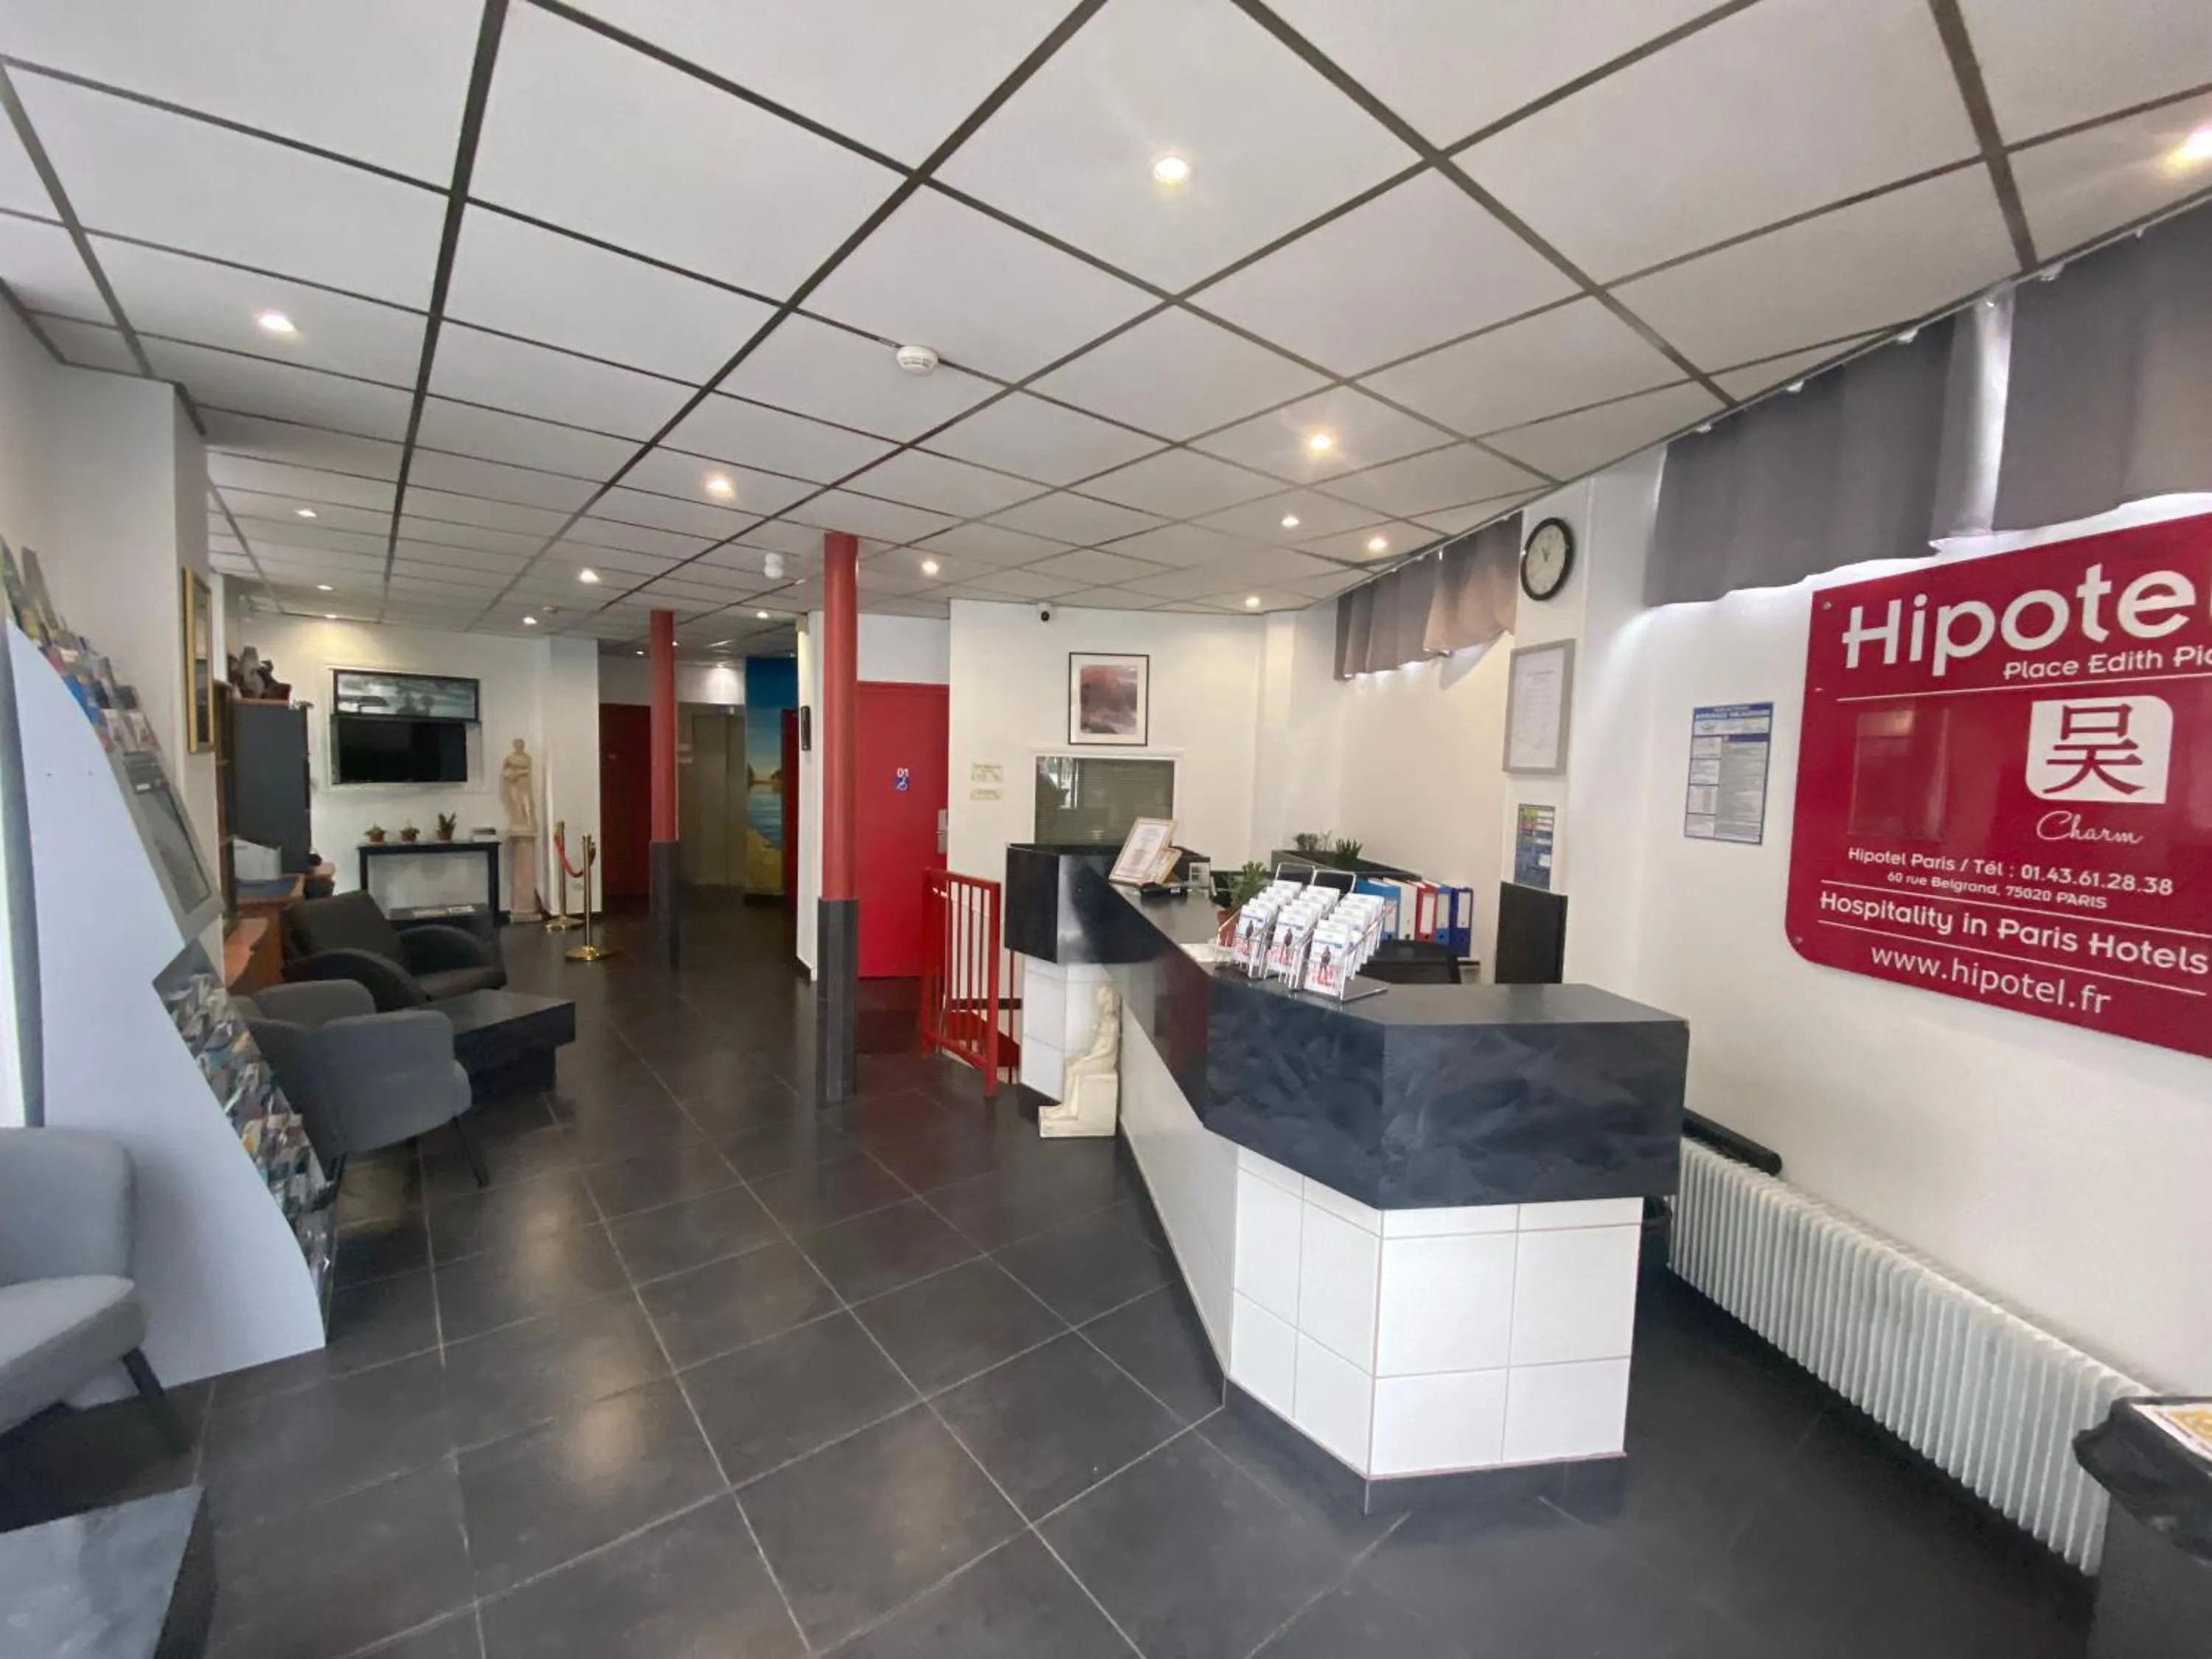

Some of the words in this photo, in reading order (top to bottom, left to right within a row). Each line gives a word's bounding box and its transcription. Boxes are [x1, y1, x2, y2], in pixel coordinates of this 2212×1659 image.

[1842, 563, 2212, 677] Hipote
[2003, 661, 2079, 681] Place
[2088, 650, 2163, 674] Edith
[2037, 810, 2144, 844] Charm
[1848, 847, 1906, 865] Hipotel
[1911, 853, 1955, 871] Paris
[1973, 859, 2003, 876] Tél
[2021, 864, 2174, 896] 01.43.61.28.38
[1887, 872, 1903, 883] 60
[1906, 876, 1927, 886] rue
[2006, 886, 2052, 902] 75020
[2056, 891, 2108, 909] PARIS
[1820, 891, 1953, 935] Hospitality
[1962, 912, 1988, 938] in
[1997, 918, 2078, 952] Paris
[2089, 933, 2210, 975] Hotels
[1871, 947, 2112, 1014] www.hipotel.fr
